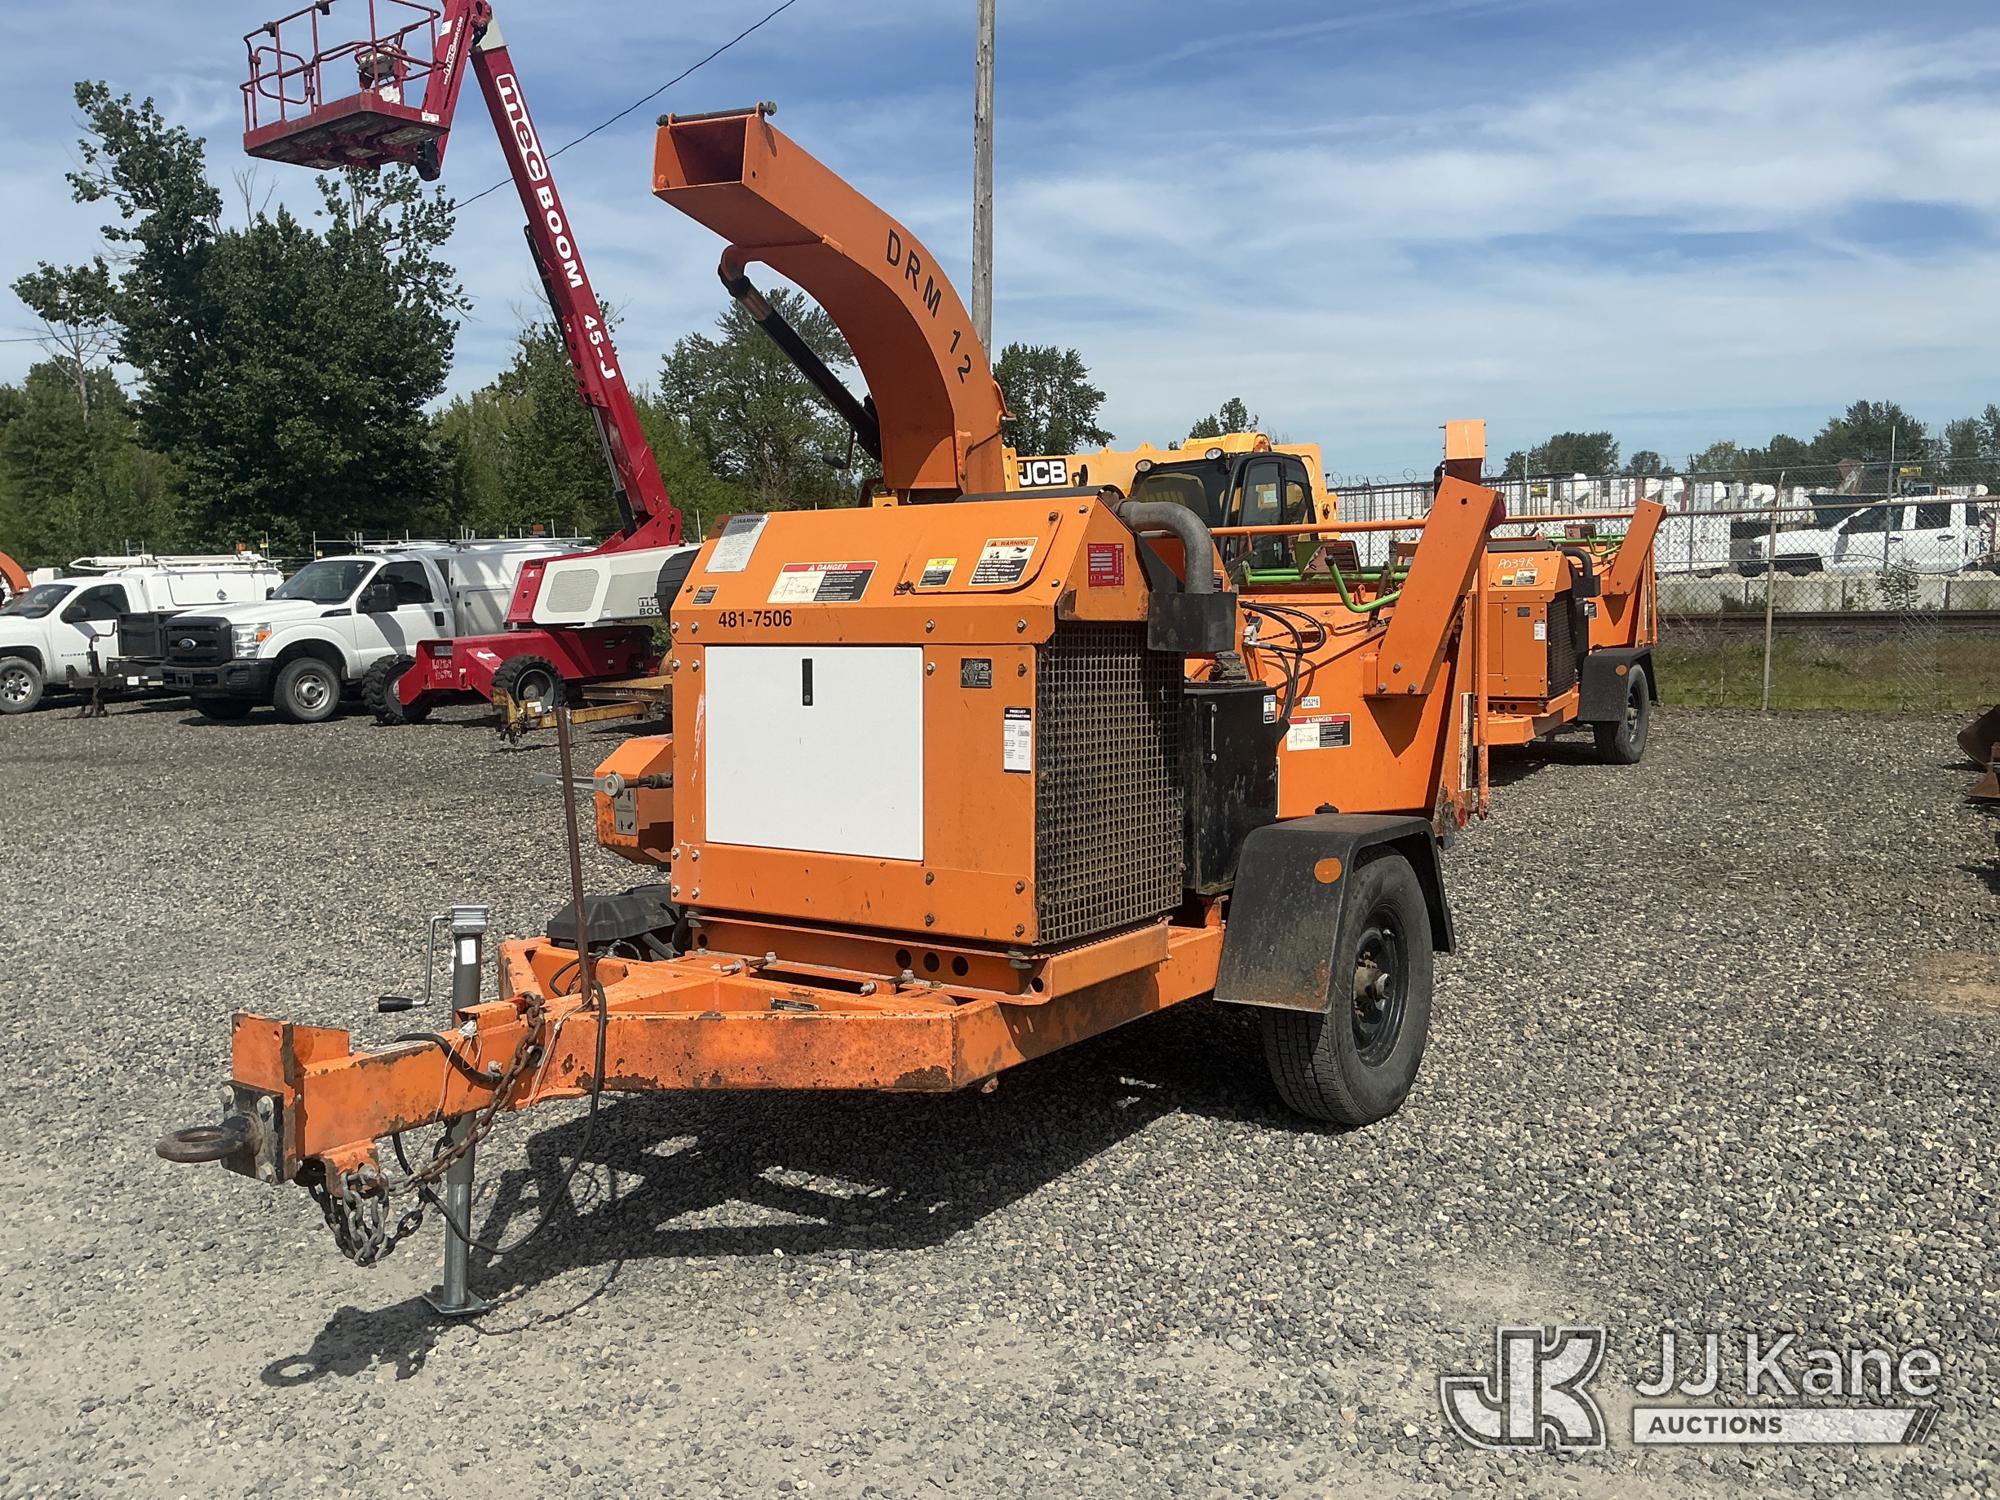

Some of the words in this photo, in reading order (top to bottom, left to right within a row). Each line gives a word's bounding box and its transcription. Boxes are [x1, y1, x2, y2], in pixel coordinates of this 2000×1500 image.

[536, 186, 584, 289] BOOM
[583, 314, 617, 380] 45-J
[886, 228, 942, 318] DRM
[950, 329, 972, 383] 12
[1019, 461, 1067, 486] JCB
[816, 563, 848, 571] DANGER
[638, 597, 659, 607] me
[639, 607, 661, 616] BOO
[718, 610, 793, 628] 481-7506
